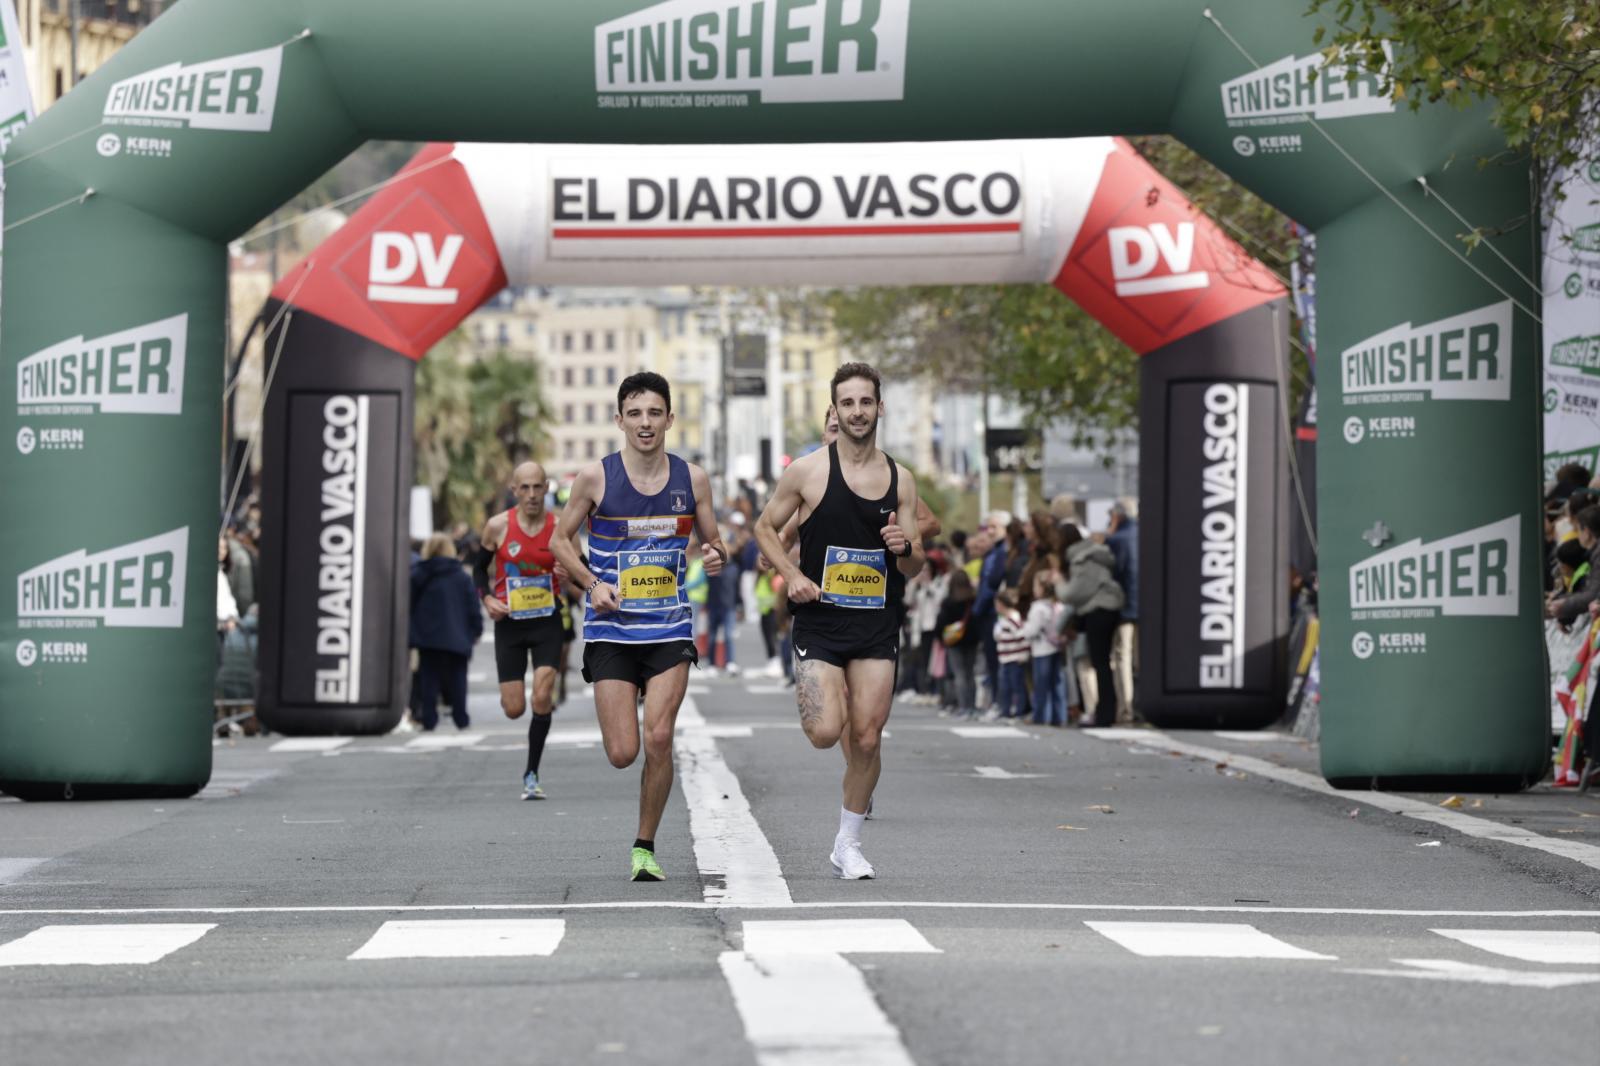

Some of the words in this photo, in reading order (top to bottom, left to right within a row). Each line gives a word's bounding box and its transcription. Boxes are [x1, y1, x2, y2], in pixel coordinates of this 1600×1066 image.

[607, 0, 881, 84] FINISHER
[111, 66, 264, 115] FINISHER
[127, 137, 171, 151] KERN
[1259, 135, 1302, 147] KERN
[553, 177, 615, 222] EL
[628, 176, 821, 222] DIARIO
[833, 171, 1021, 219] VASCO
[369, 231, 464, 287] DV
[1108, 222, 1195, 280] DV
[22, 336, 172, 398] FINISHER
[1347, 322, 1500, 388] FINISHER
[40, 428, 84, 443] KERN
[1203, 383, 1238, 509] VASCO
[1369, 416, 1415, 430] KERN
[321, 394, 359, 522] VASCO
[23, 550, 174, 611] FINISHER
[631, 576, 673, 586] BASTIEN
[643, 555, 672, 563] ZURICH
[836, 573, 880, 584] ALVARO
[851, 554, 880, 562] ZURICH
[1201, 511, 1236, 641] DIARIO
[1355, 538, 1509, 603] FINISHER
[318, 523, 355, 656] DIARIO
[42, 642, 87, 656] KERN
[1379, 632, 1426, 647] KERN
[315, 659, 349, 703] EL
[1200, 644, 1233, 689] EL
